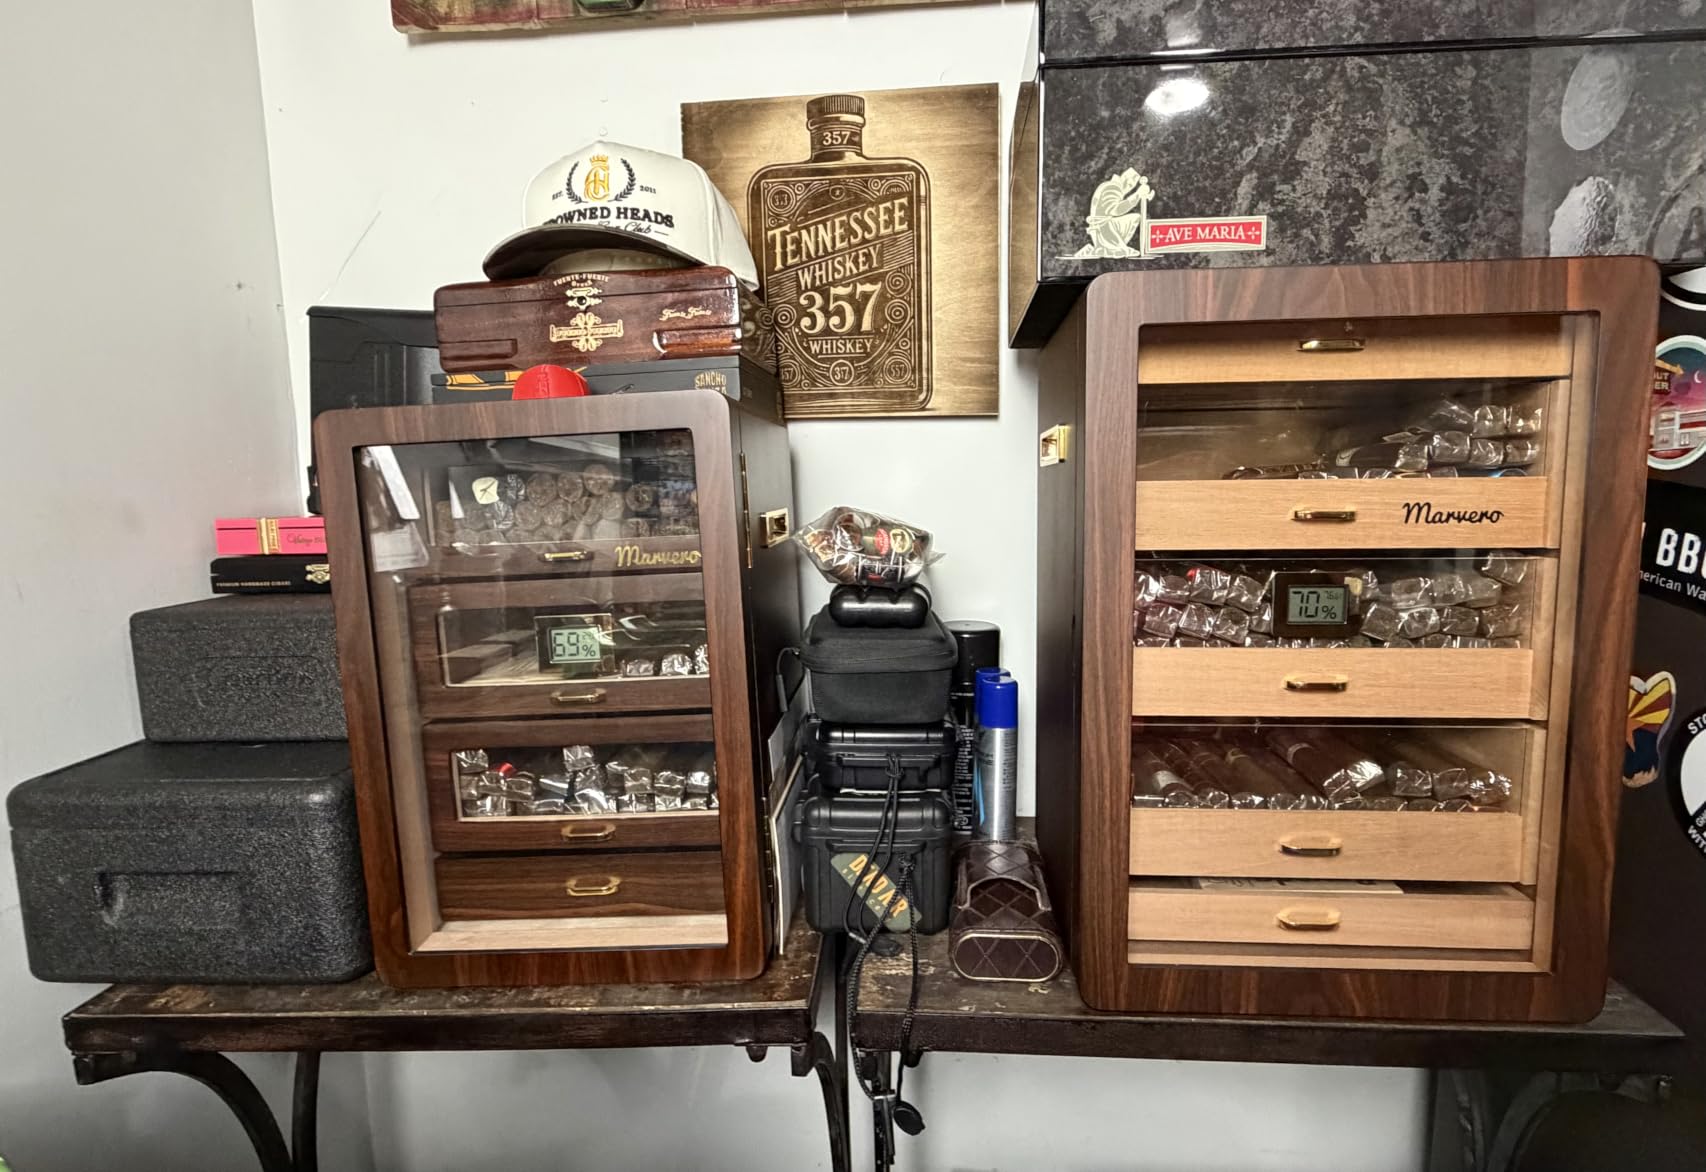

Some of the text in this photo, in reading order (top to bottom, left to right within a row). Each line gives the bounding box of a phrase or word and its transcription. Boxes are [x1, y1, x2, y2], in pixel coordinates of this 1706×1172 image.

[823, 131, 850, 145] 357
[639, 185, 657, 194] 2011
[543, 206, 611, 226] OWNED
[615, 207, 675, 228] HEADS
[767, 197, 909, 271] TENNESSEE
[1165, 225, 1245, 244] AVE MARIA
[797, 243, 882, 290] WHISKEY
[799, 280, 883, 334] 357
[809, 337, 873, 354] WHISKEY
[694, 371, 727, 387] SANCHO
[1653, 372, 1670, 380] UT
[1402, 502, 1505, 524] Marvero
[615, 545, 702, 567] Marvero
[1640, 570, 1682, 592] erican
